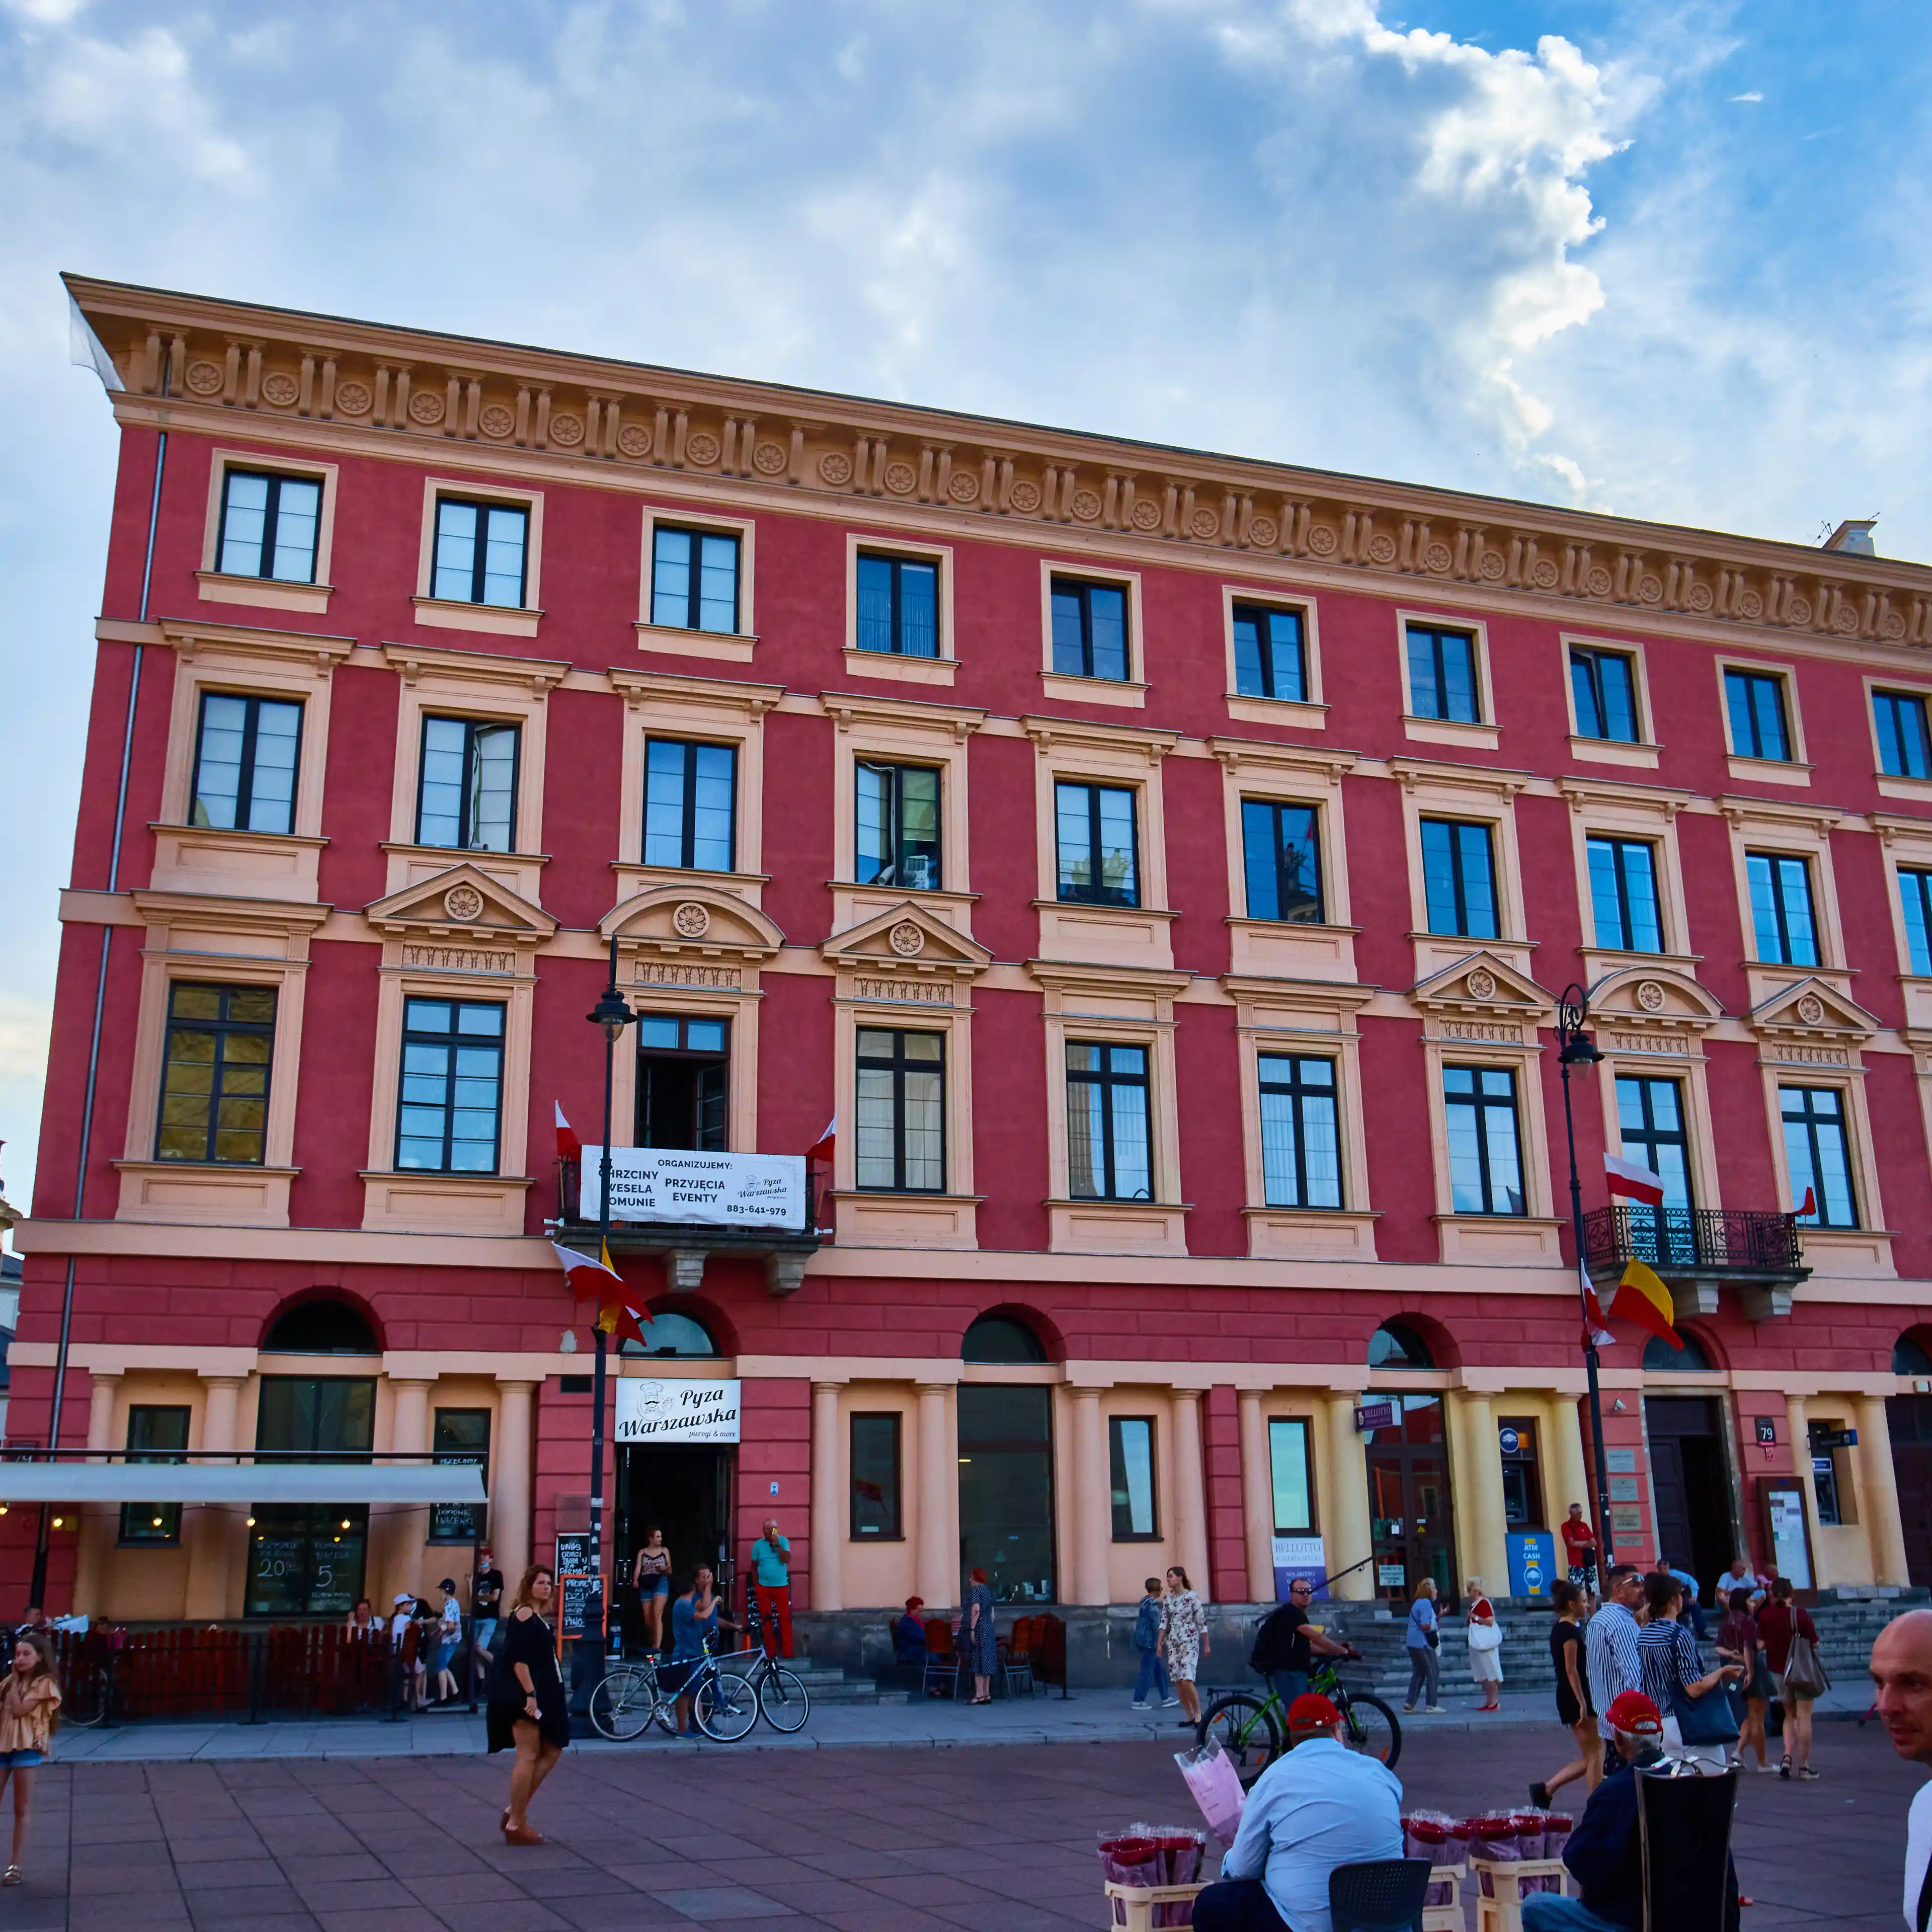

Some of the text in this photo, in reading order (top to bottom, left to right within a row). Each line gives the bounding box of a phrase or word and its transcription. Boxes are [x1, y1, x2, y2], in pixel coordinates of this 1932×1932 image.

[658, 1159, 732, 1169] ORGANIZUJEMY:
[665, 1178, 725, 1191] PRZYJĘCIA
[763, 1178, 781, 1187] Pyza
[673, 1192, 718, 1203] EVENTY
[738, 1186, 787, 1198] Warszawska
[609, 1197, 656, 1207] OMUNIE
[727, 1204, 786, 1216] 883-641-979
[680, 1389, 724, 1408] Pyza
[1364, 1406, 1391, 1418] BELLOTTO
[619, 1408, 737, 1437] Warszawska
[688, 1429, 711, 1439] pierogi
[1760, 1427, 1773, 1440] 79
[1275, 1543, 1321, 1553] BELLOTTO
